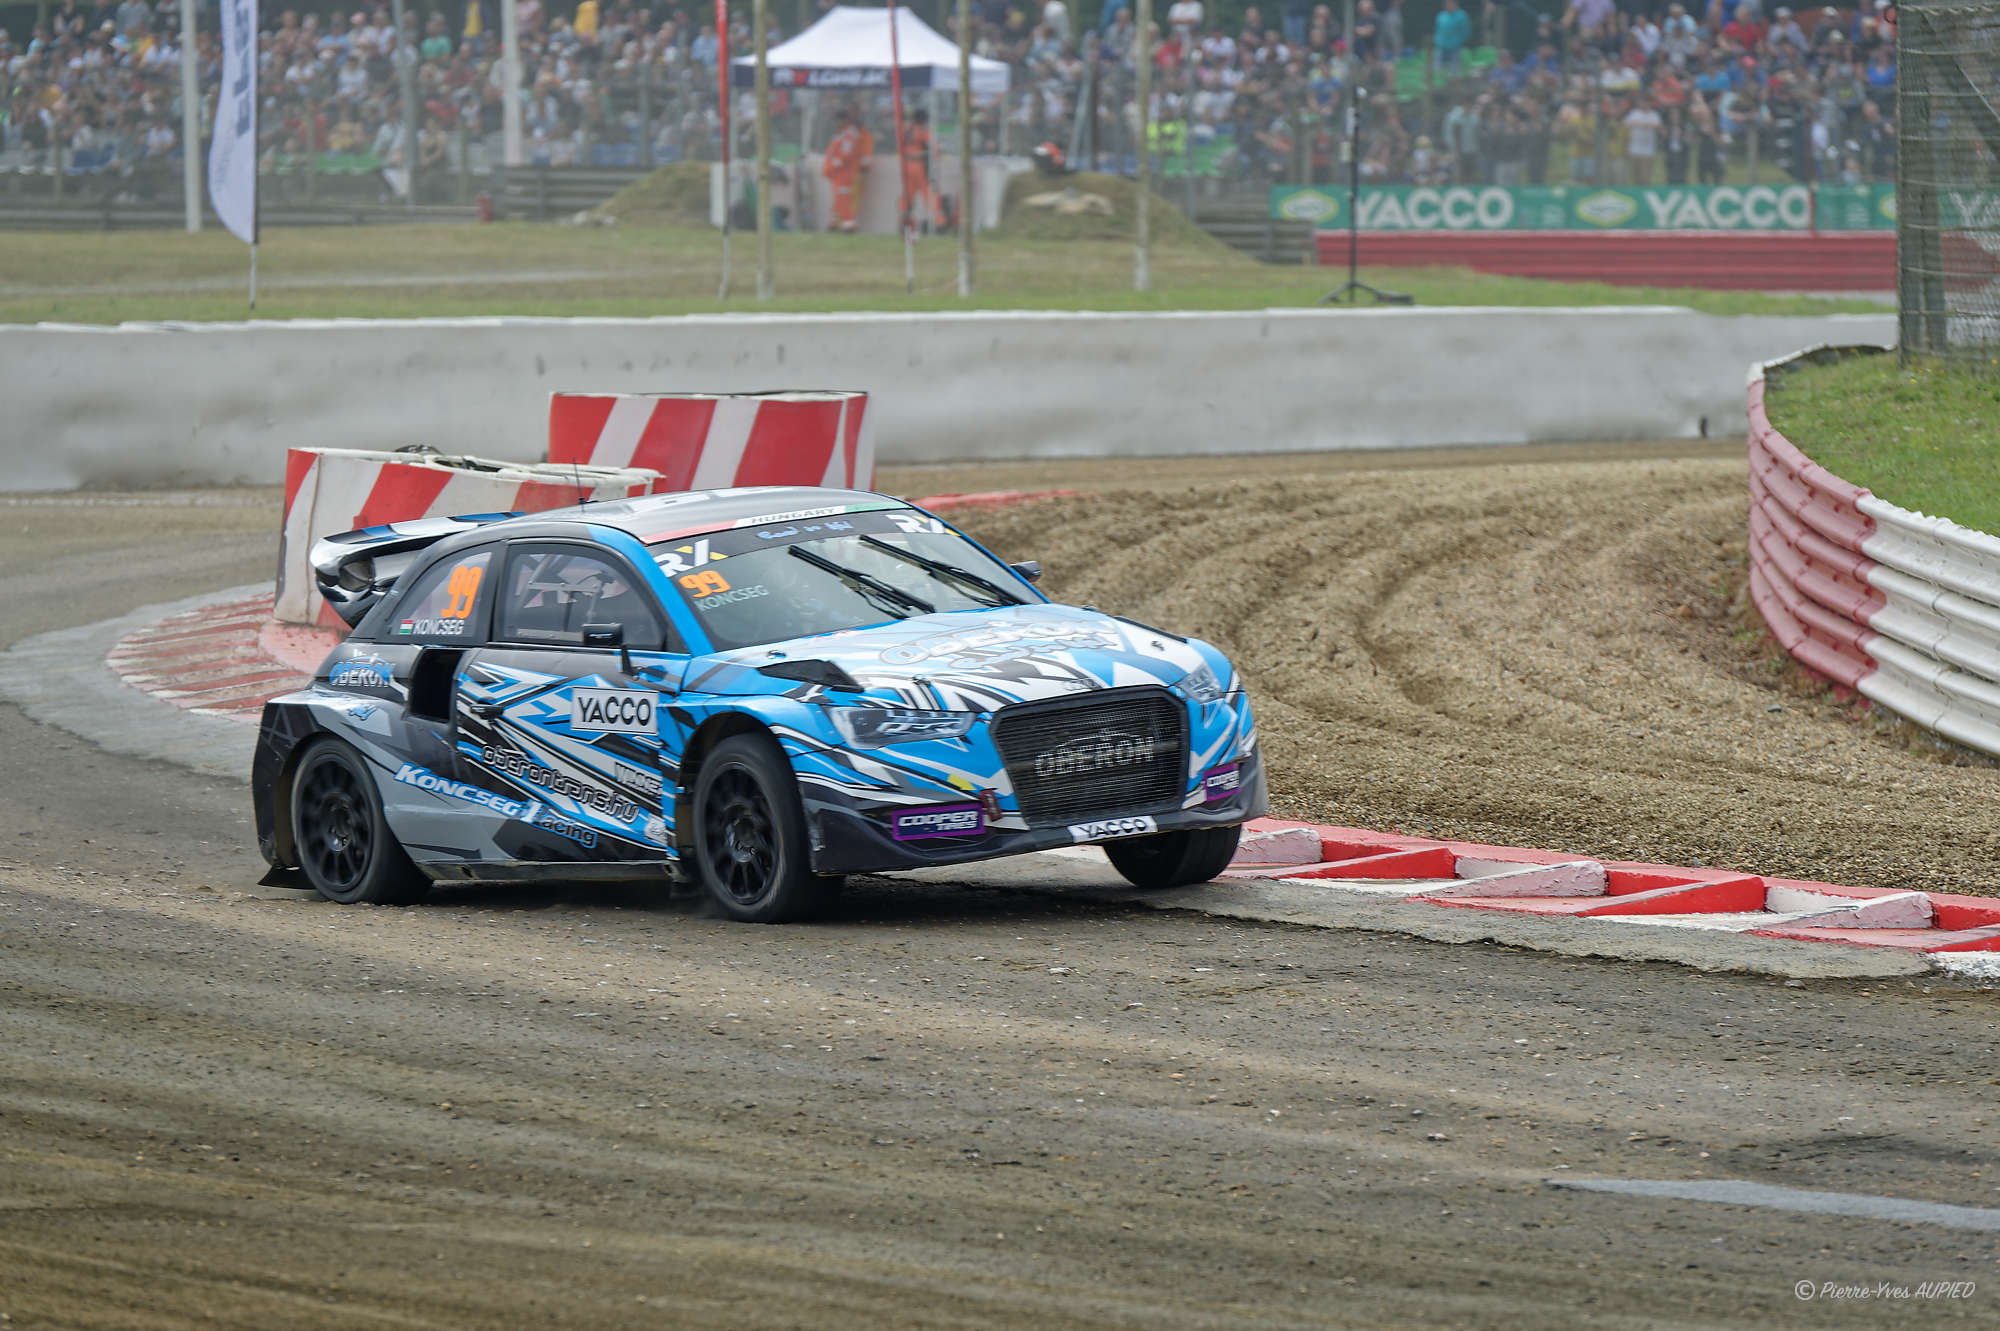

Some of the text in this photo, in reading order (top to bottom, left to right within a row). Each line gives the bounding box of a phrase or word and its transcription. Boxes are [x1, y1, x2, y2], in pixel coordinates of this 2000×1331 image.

[1348, 187, 1514, 228] YACCO
[1643, 186, 1810, 228] YACCO
[751, 508, 836, 524] HUNGARY
[653, 539, 729, 578] RX
[441, 565, 483, 619] 99
[679, 570, 731, 598] 99
[695, 584, 770, 612] KONCSEG
[412, 619, 465, 635] KONCSEG
[577, 696, 652, 726] YACCO
[1034, 736, 1155, 778] OBERON
[897, 811, 979, 827] COOPER
[936, 820, 978, 832] TIRES
[1079, 818, 1148, 839] YACCO
